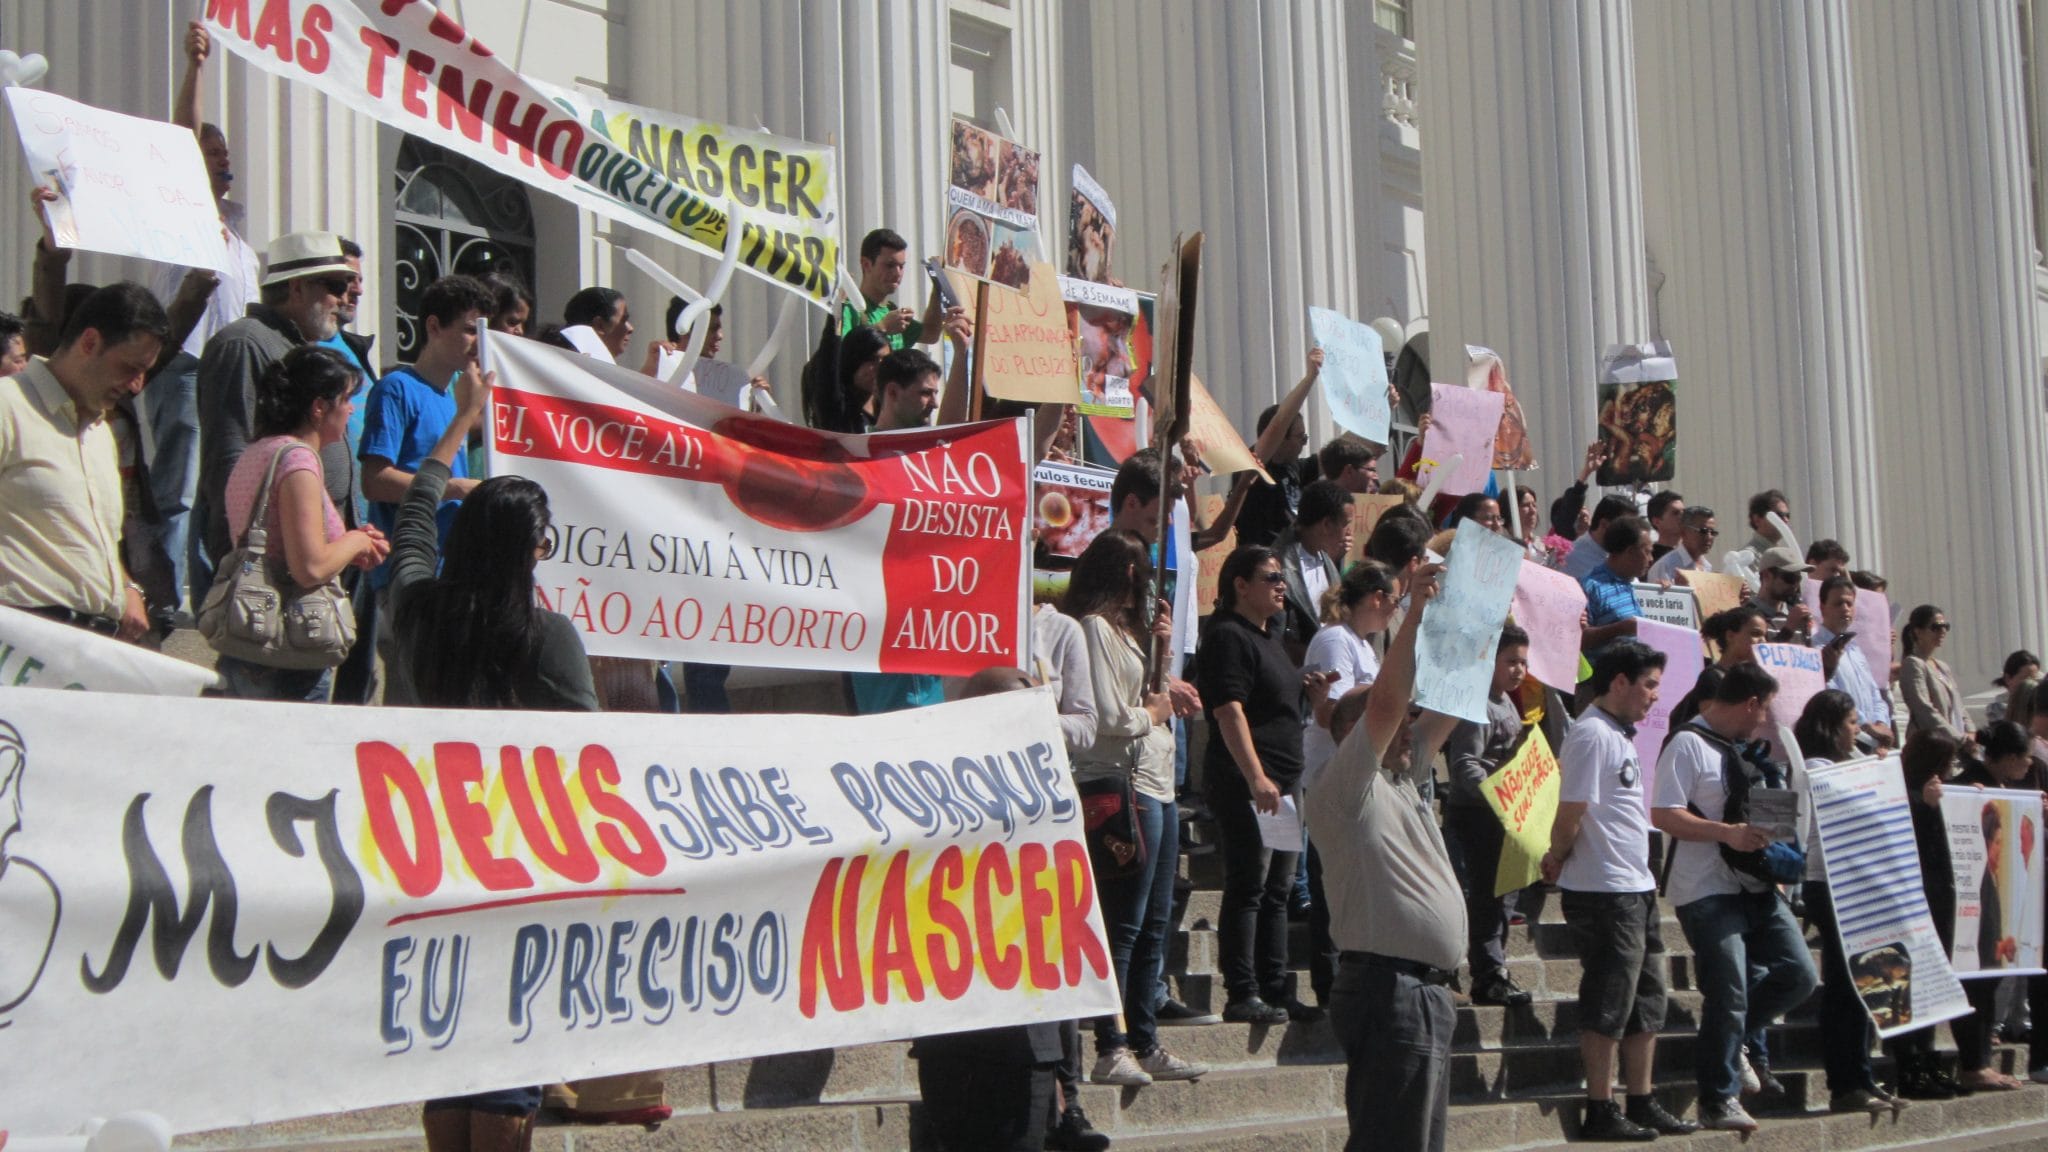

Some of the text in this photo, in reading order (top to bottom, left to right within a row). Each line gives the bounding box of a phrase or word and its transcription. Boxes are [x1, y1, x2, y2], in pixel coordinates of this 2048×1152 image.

[206, 0, 333, 75] MAS
[359, 25, 586, 182] TENHO
[494, 402, 533, 453] EI,
[543, 411, 649, 461] VOCÊ
[895, 438, 1001, 498] NÃO
[899, 497, 1014, 541] DESISTA
[538, 523, 636, 571] DIGA
[647, 532, 713, 578] SIM
[752, 545, 840, 591] VIDA
[929, 554, 980, 596] DO
[536, 577, 867, 653] NÃO AO ABORTO
[891, 607, 1010, 656] AMOR.
[355, 740, 1077, 899] DEUS SABE PORQUE
[1494, 770, 1523, 812] NÃO
[379, 839, 1110, 1057] EU PRECISO NASCER
